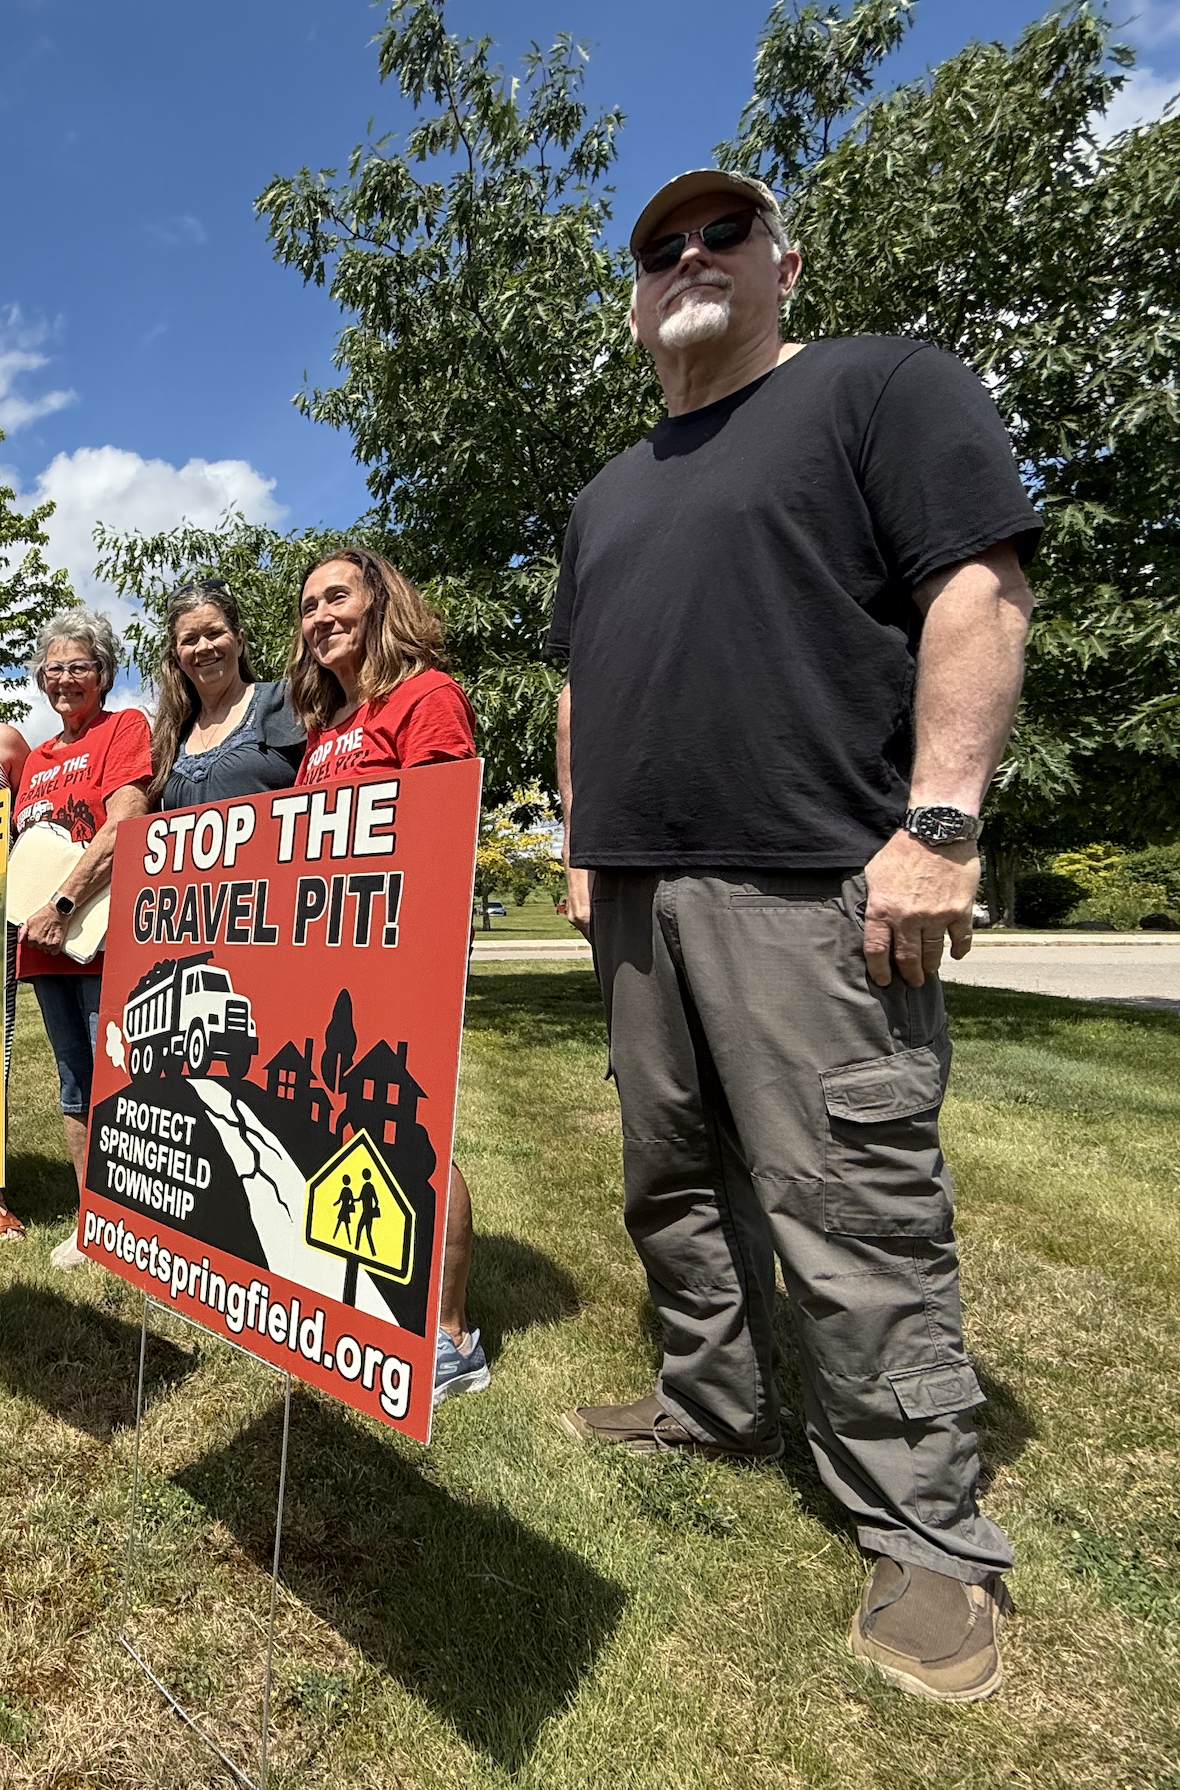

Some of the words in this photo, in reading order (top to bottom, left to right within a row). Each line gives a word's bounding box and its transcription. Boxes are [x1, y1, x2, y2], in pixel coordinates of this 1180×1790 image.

[30, 765, 61, 789] STOP
[62, 754, 89, 775] THE
[307, 740, 333, 770] TOP
[334, 727, 363, 756] THE
[20, 779, 58, 803] GRAVEL
[63, 766, 91, 787] PIT!
[143, 802, 256, 876] STOP
[270, 778, 401, 865] THE
[133, 879, 278, 946] GRAVEL
[292, 871, 404, 948] PIT!
[116, 1096, 197, 1147] PROTECT
[98, 1124, 211, 1190] SPRINGFIELD
[106, 1161, 196, 1222] TOWNSHIP
[82, 1206, 413, 1421] protectspringfield.org
